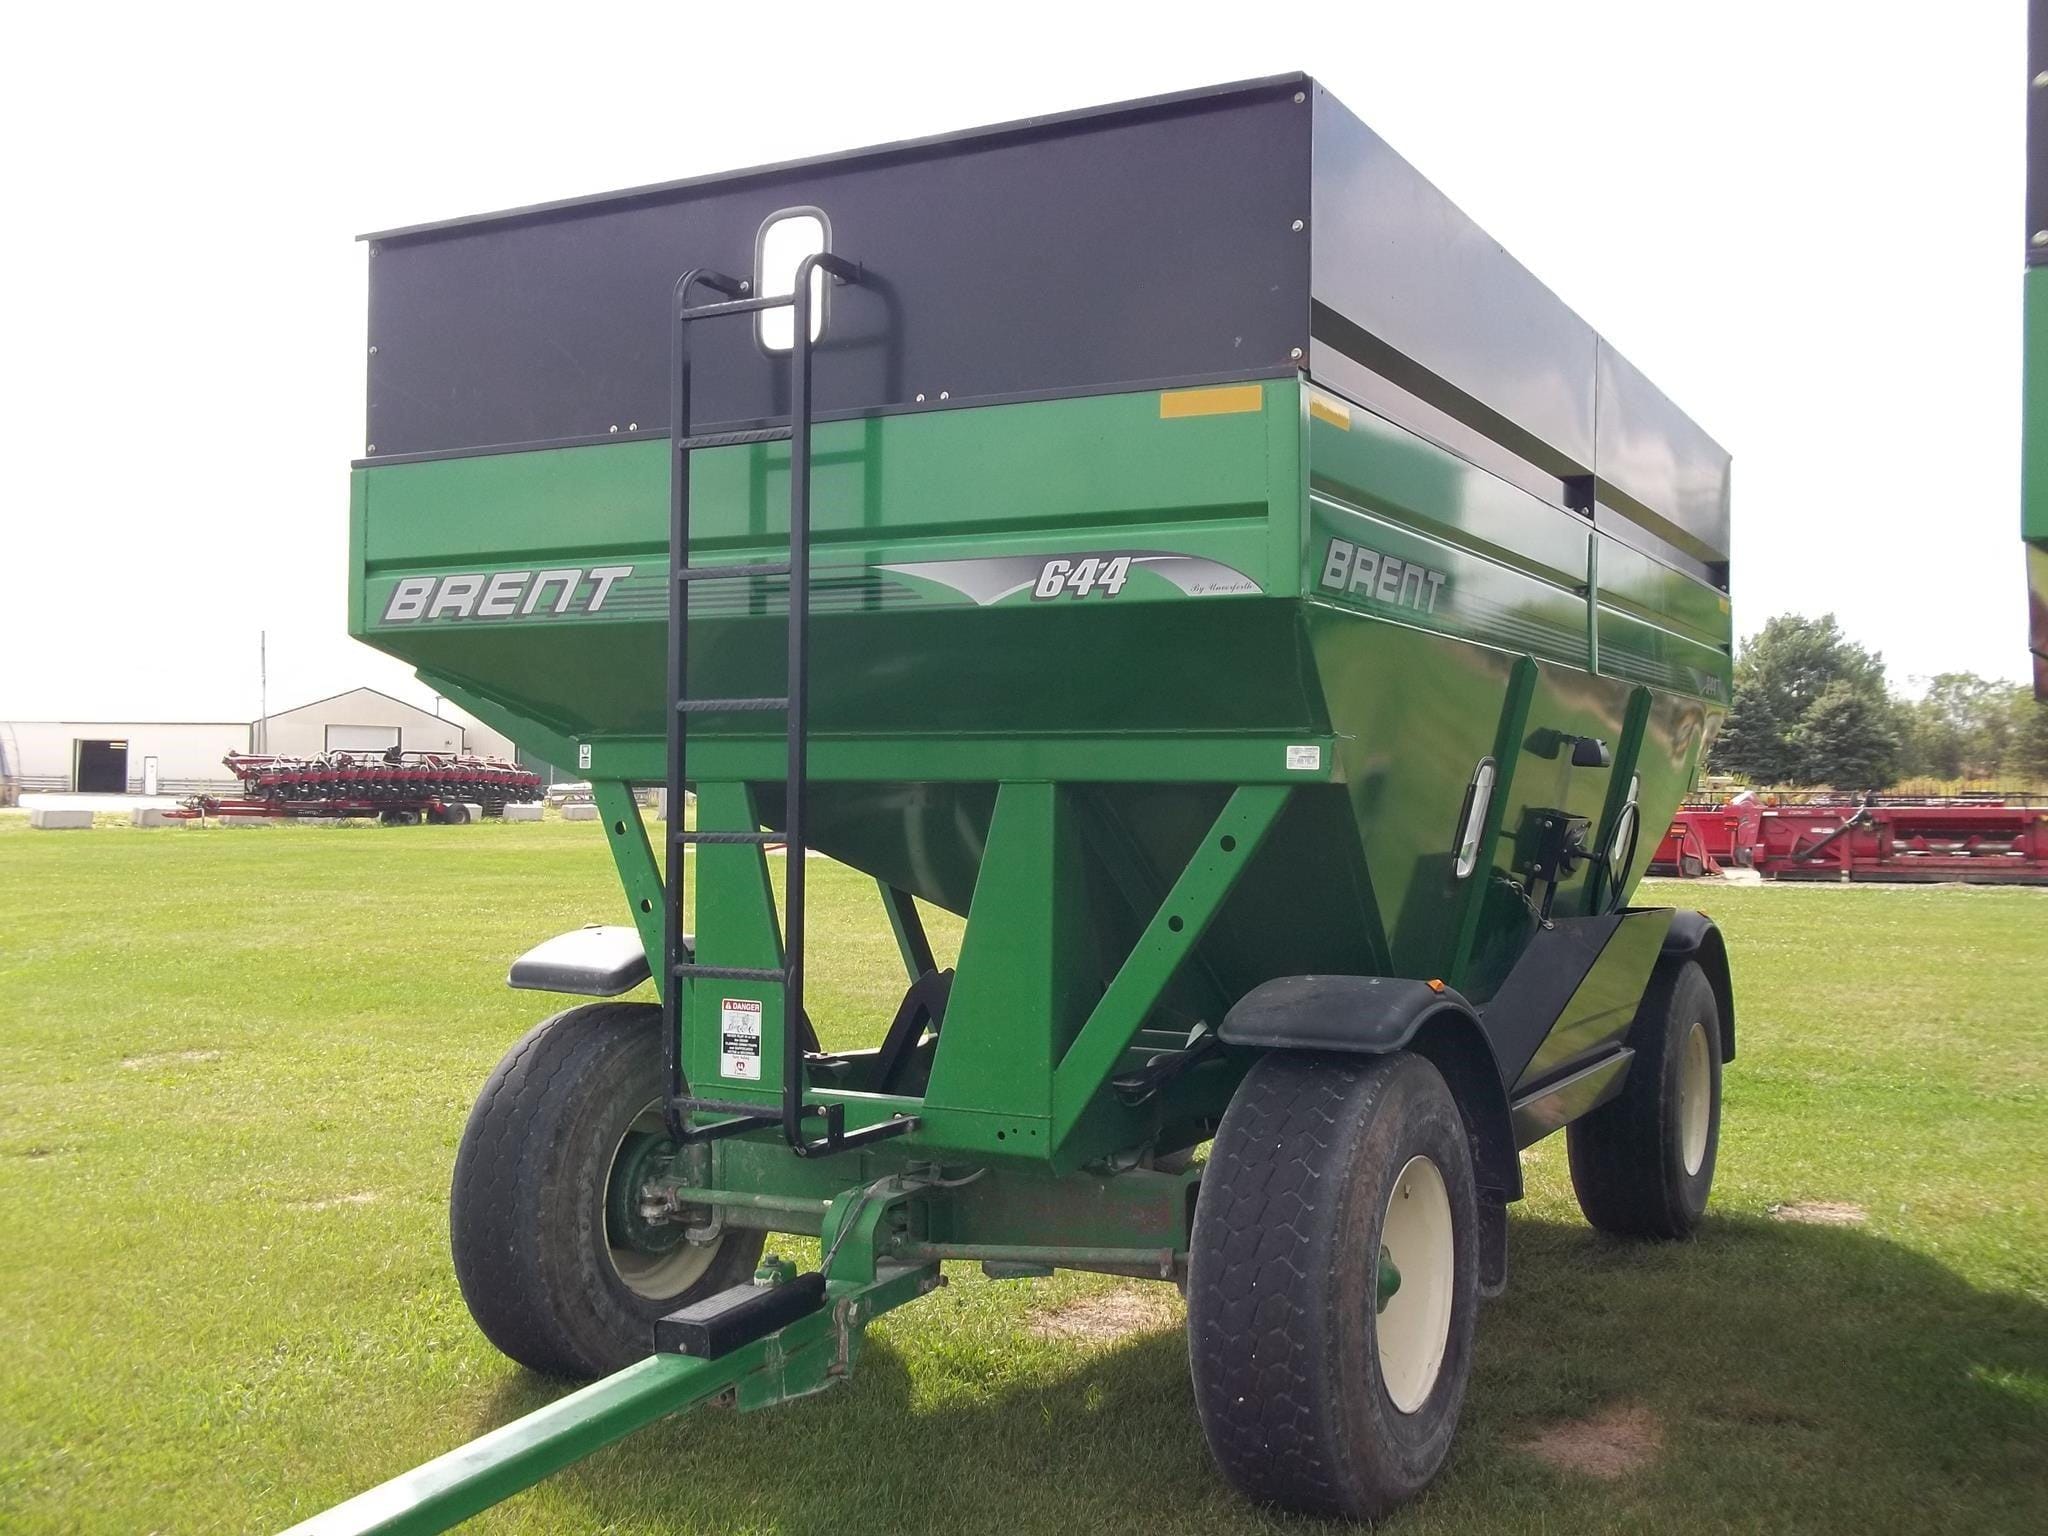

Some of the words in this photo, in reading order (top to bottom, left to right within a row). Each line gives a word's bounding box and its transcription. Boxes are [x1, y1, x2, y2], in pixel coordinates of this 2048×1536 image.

[381, 565, 635, 622] BRENT
[1033, 556, 1132, 599] 644
[1320, 537, 1446, 615] BRENT
[732, 1002, 760, 1011] DANGER
